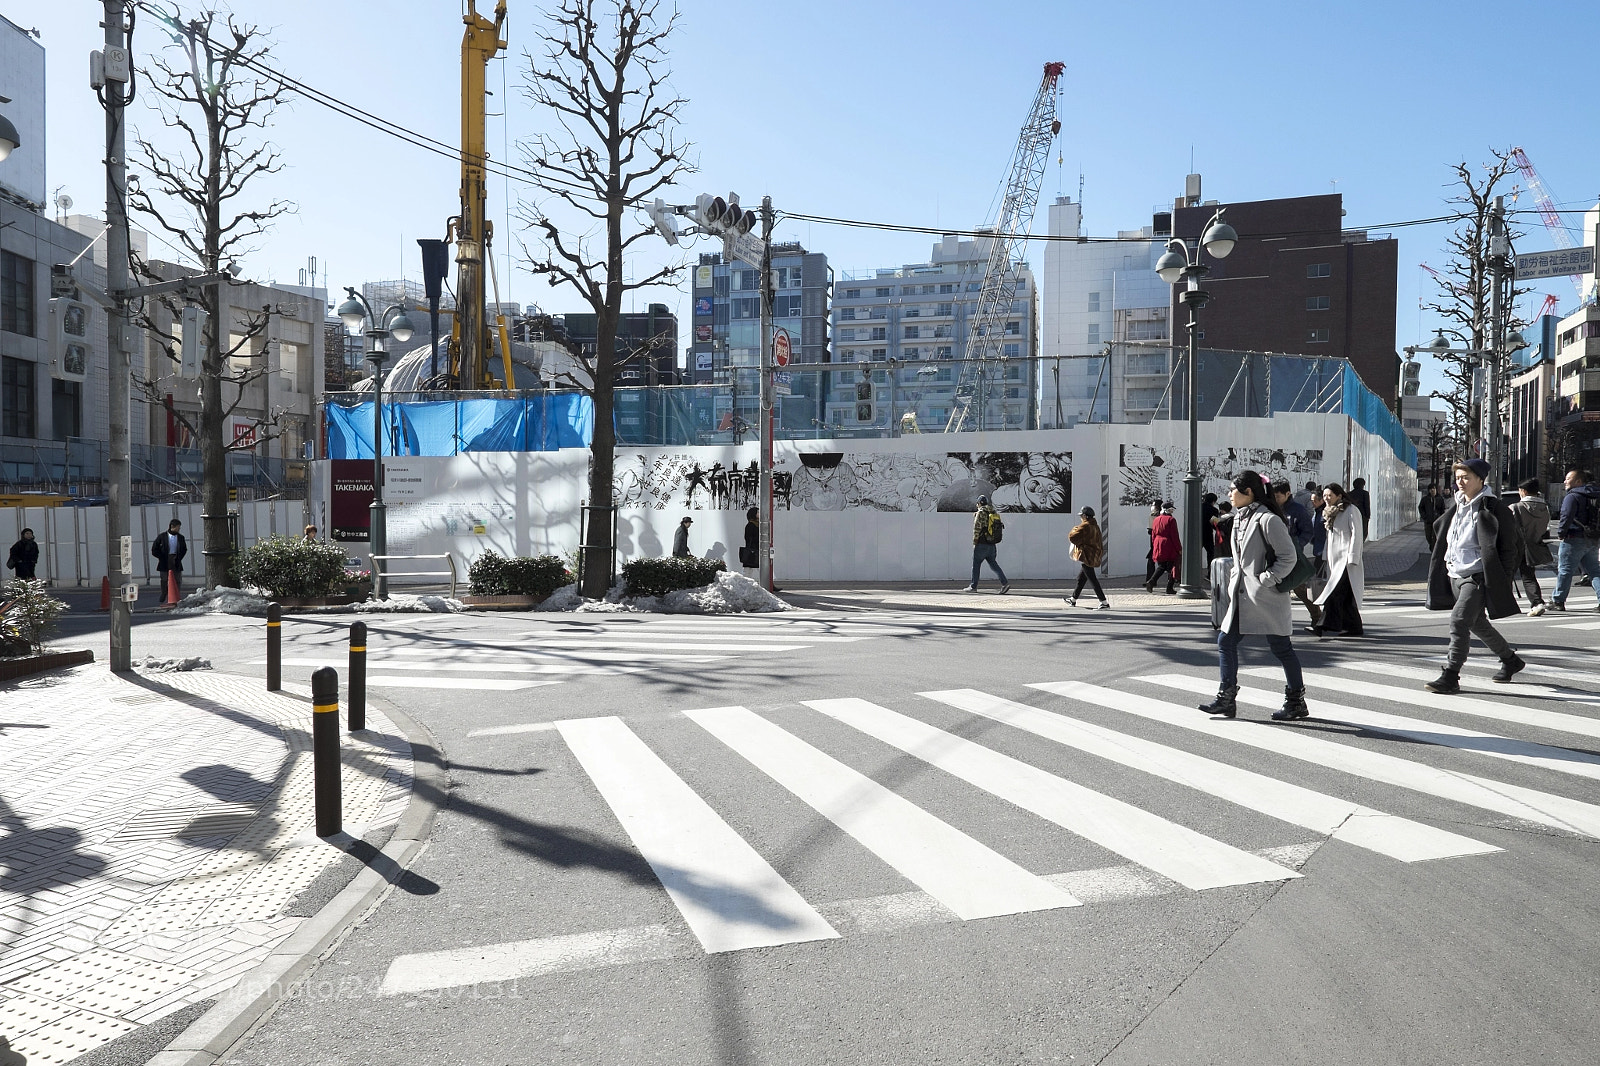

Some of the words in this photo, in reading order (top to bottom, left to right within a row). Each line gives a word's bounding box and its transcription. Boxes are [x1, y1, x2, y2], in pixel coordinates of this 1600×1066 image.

[1519, 250, 1591, 269] 勤労福祉会館前
[1518, 270, 1536, 278] Labor
[1552, 265, 1577, 274] Welfare
[1578, 263, 1590, 271] hall
[236, 426, 253, 437] UNI
[334, 484, 374, 492] TAKENAKA
